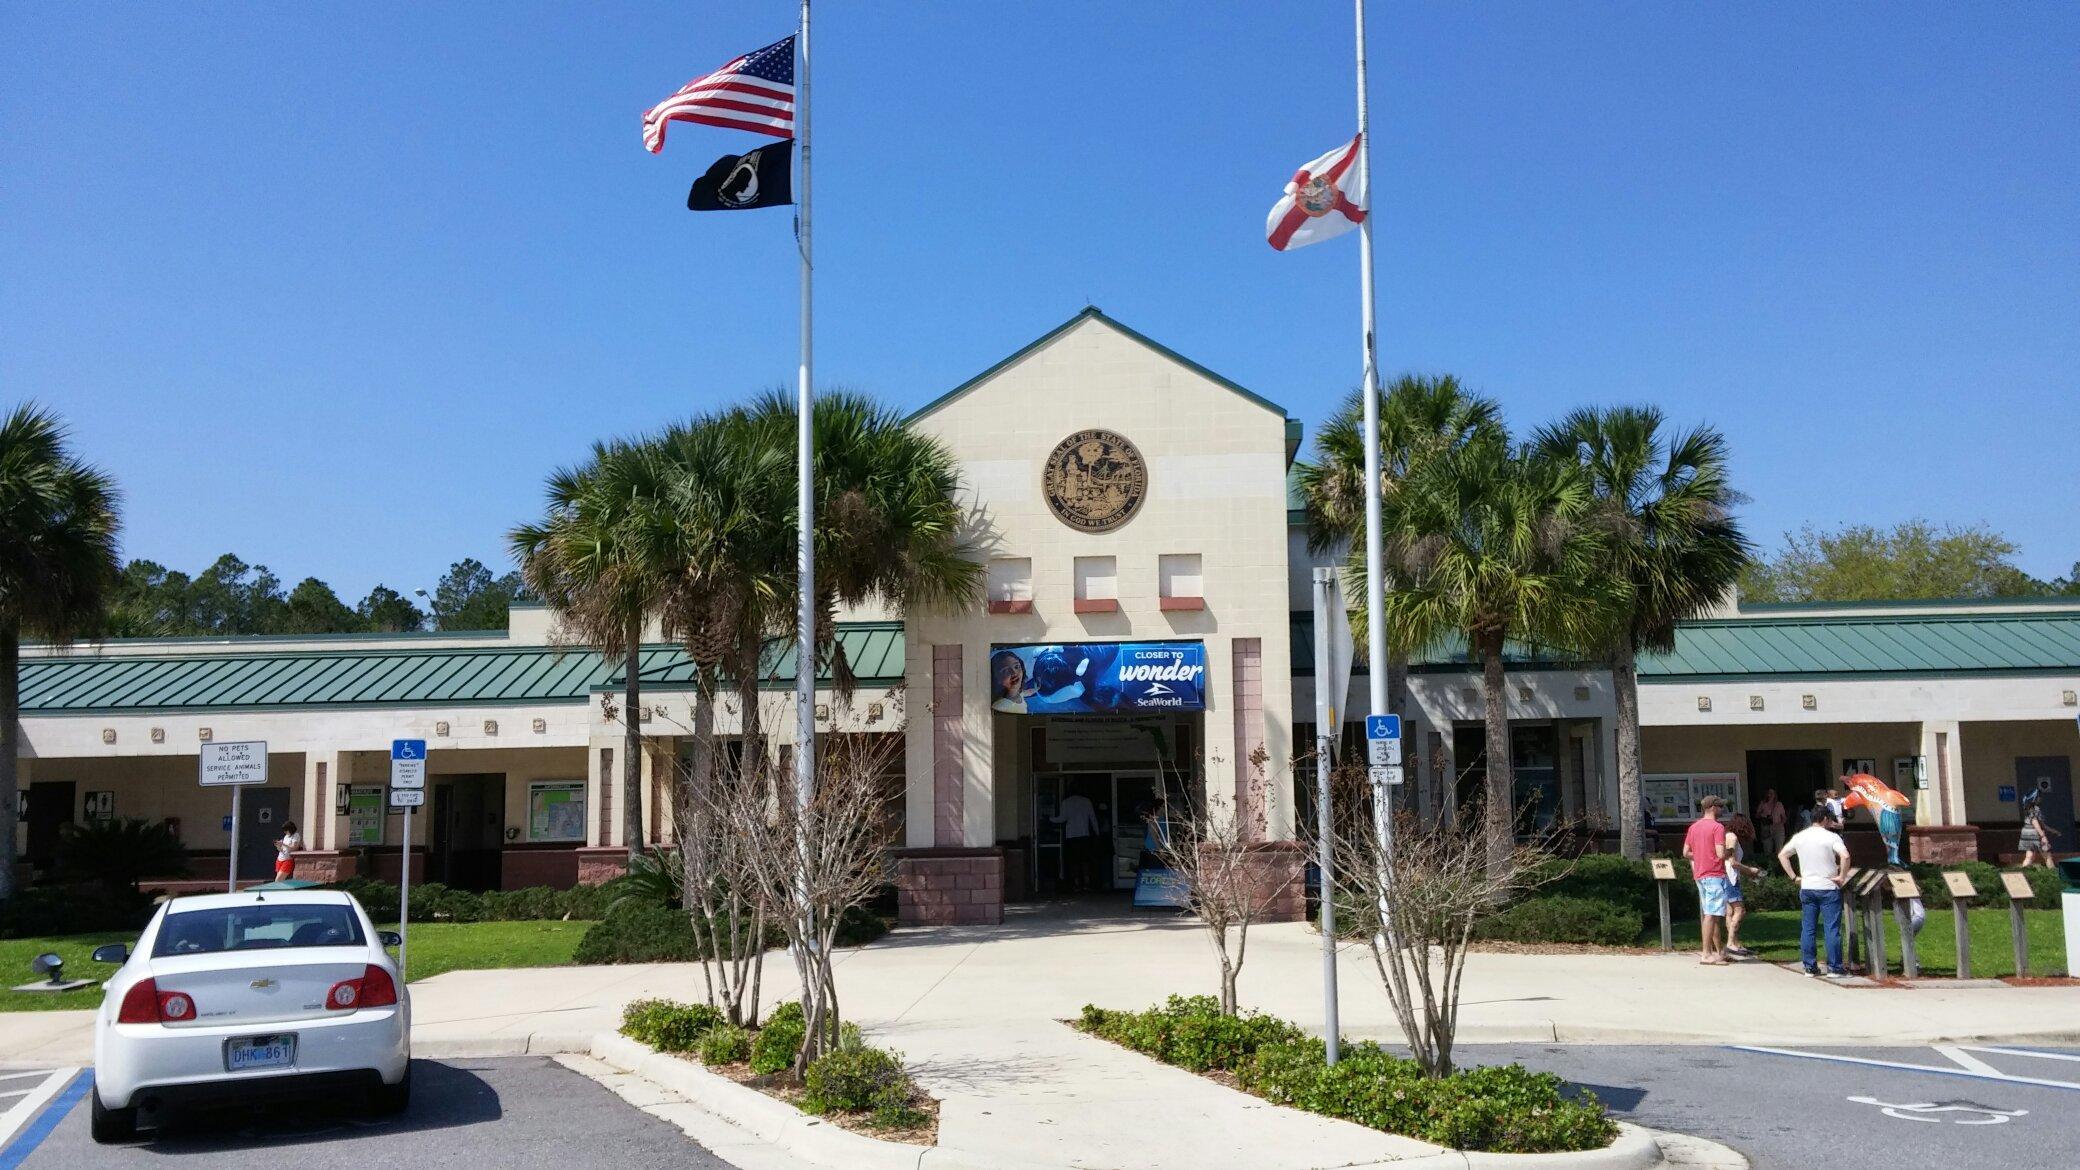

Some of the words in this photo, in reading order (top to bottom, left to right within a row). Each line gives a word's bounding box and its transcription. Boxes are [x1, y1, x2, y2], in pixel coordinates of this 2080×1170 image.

[1046, 465, 1055, 497] GREAT
[1051, 443, 1068, 465] SEAL
[1080, 432, 1097, 441] THE
[1101, 432, 1125, 448] STATE
[1132, 459, 1142, 497] FLORIDA
[1060, 508, 1070, 518] IN
[1070, 514, 1087, 526] GOD
[1088, 519, 1101, 527] WE
[1101, 508, 1127, 526] TRUST
[1171, 651, 1184, 659] TO
[1119, 659, 1203, 681] wonder
[1137, 697, 1182, 707] SeaWorld
[217, 773, 250, 781] PERMITTED
[234, 1048, 257, 1063] DHK
[265, 1046, 289, 1060] 861
